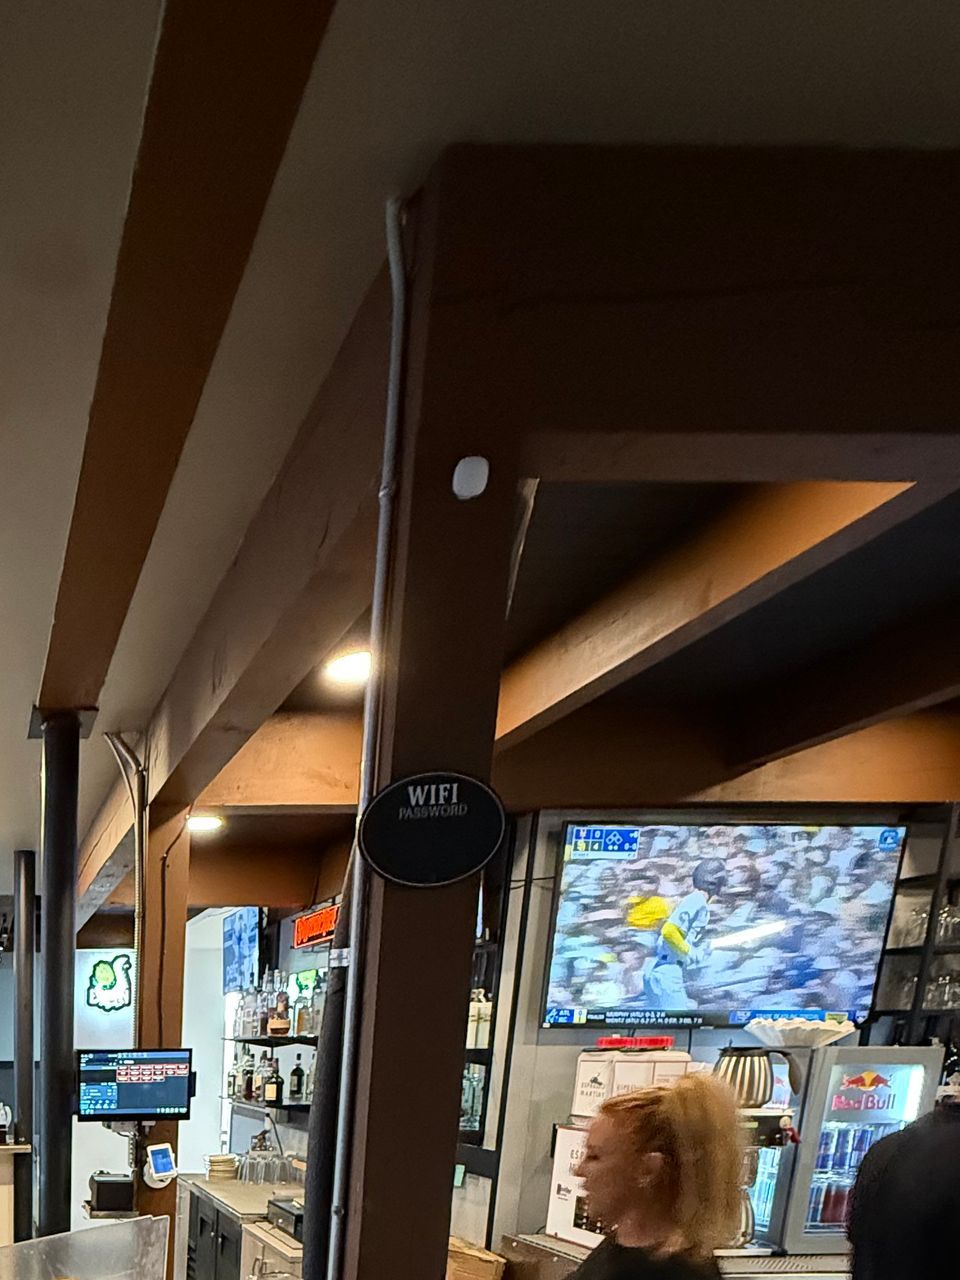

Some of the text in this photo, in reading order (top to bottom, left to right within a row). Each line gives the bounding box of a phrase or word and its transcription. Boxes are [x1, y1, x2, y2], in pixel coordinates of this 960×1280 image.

[408, 783, 458, 806] WIFI
[398, 803, 468, 820] PASSWORD
[831, 1093, 896, 1110] Red Bull
